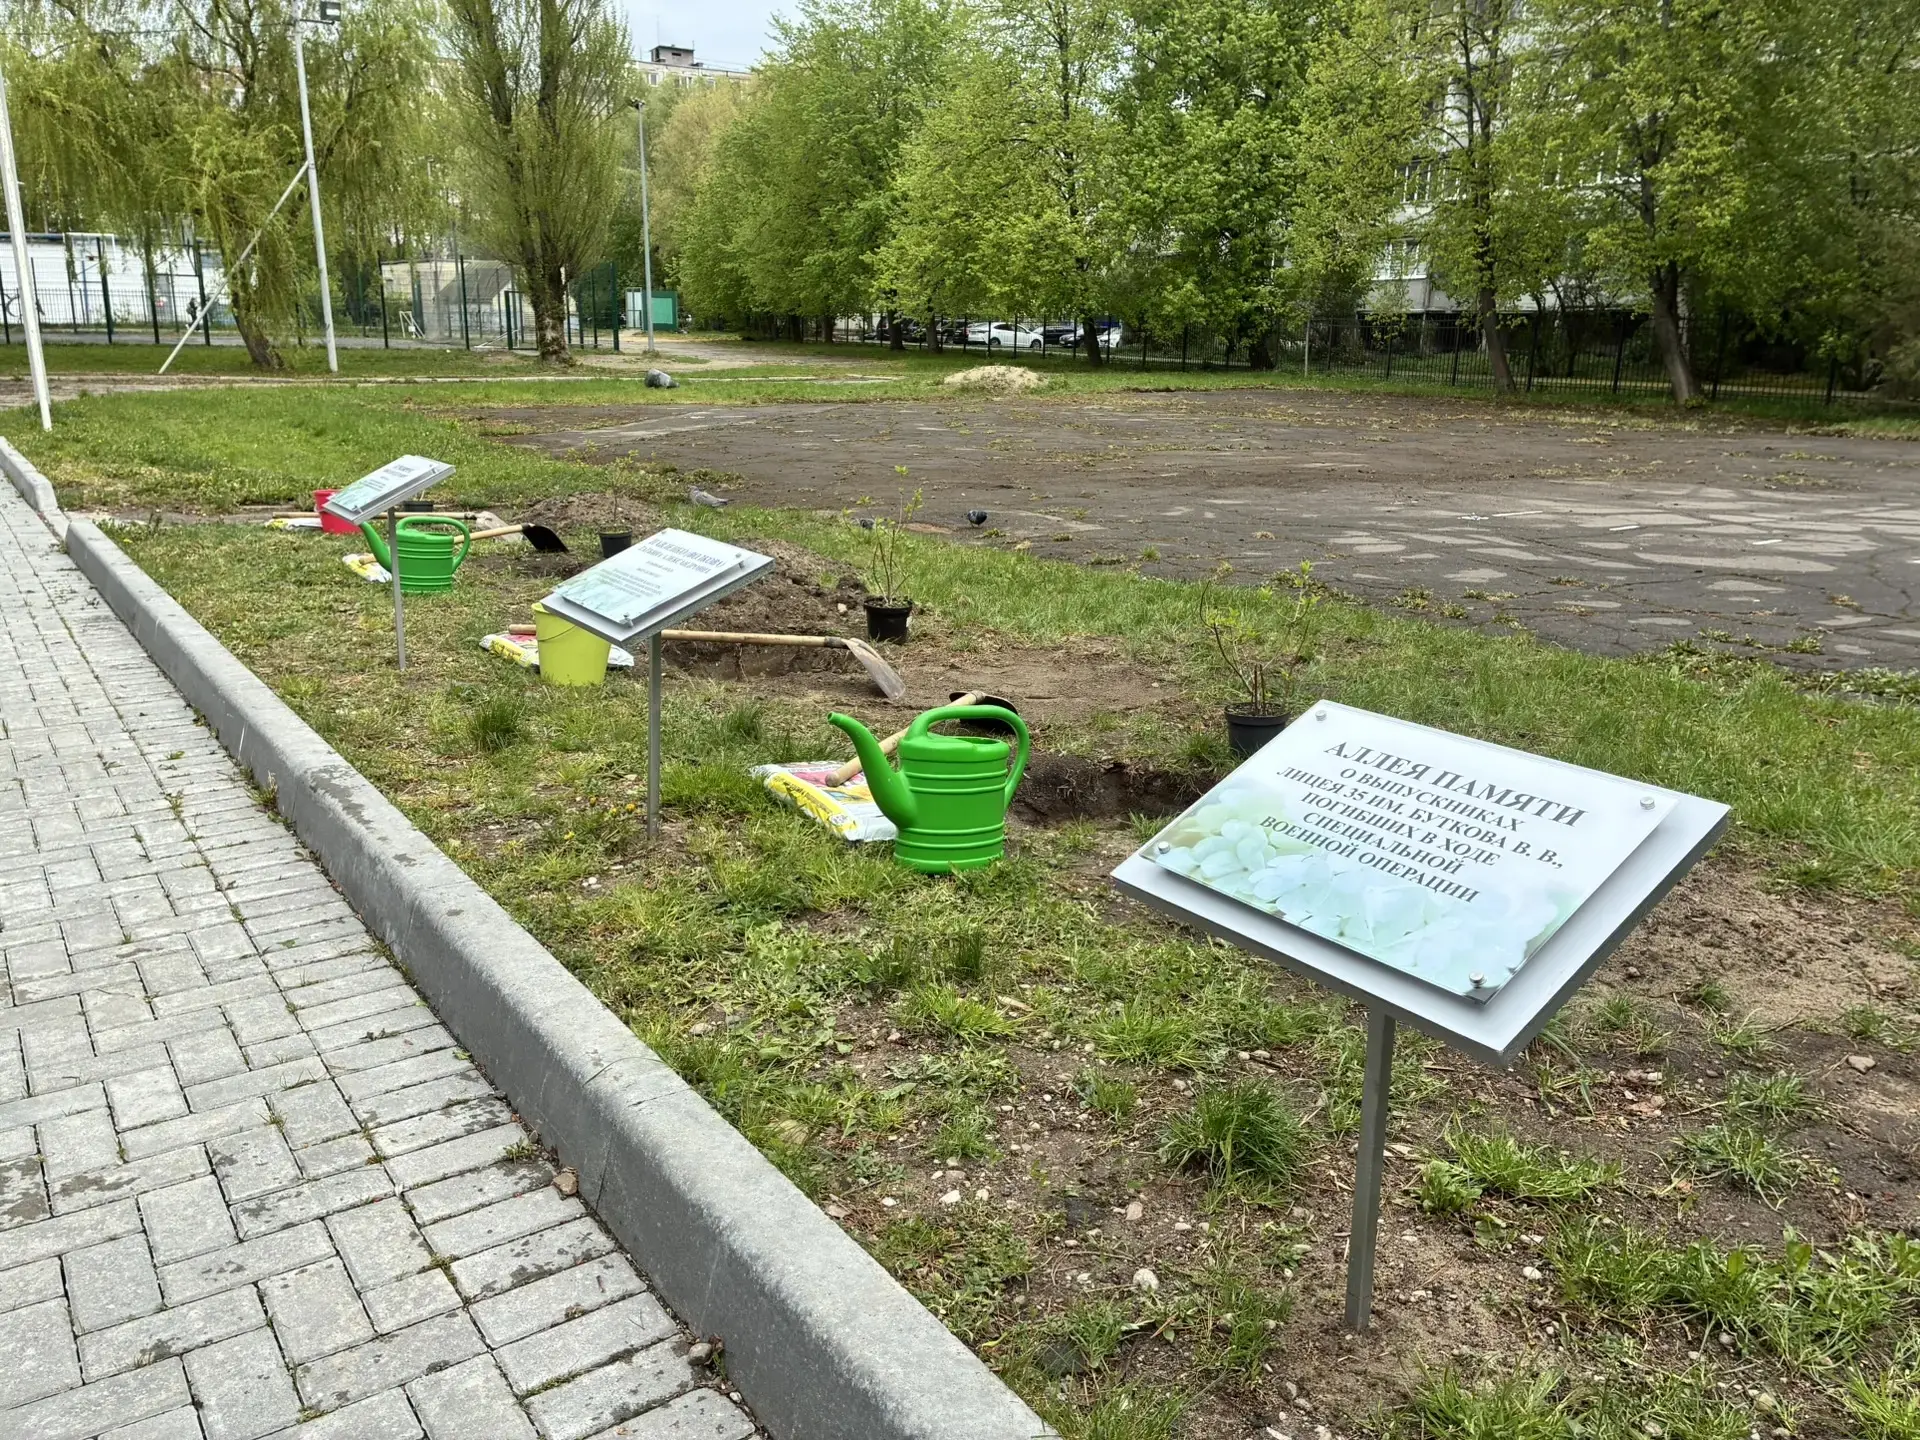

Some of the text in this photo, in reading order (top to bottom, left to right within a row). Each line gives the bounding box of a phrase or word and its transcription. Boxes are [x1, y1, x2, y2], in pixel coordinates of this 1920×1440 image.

[1276, 767, 1346, 794] ЛИЦЕЯ
[1344, 788, 1368, 801] 35
[1366, 795, 1407, 815] ИМ.
[1408, 808, 1507, 849] БУТКОВА
[1510, 841, 1531, 857] В.
[1324, 742, 1588, 827] АЛЛЕЯ ПАМЯТИ
[1340, 768, 1526, 832] О ВЫПУСКНИКАХ
[1259, 816, 1480, 903] ВОЕННОЙ ОПЕРАЦИИ
[1300, 792, 1501, 867] ПОГИБШИХ В ХОДЕ
[1303, 812, 1466, 875] СПЕЦИАЛЬНОЙ
